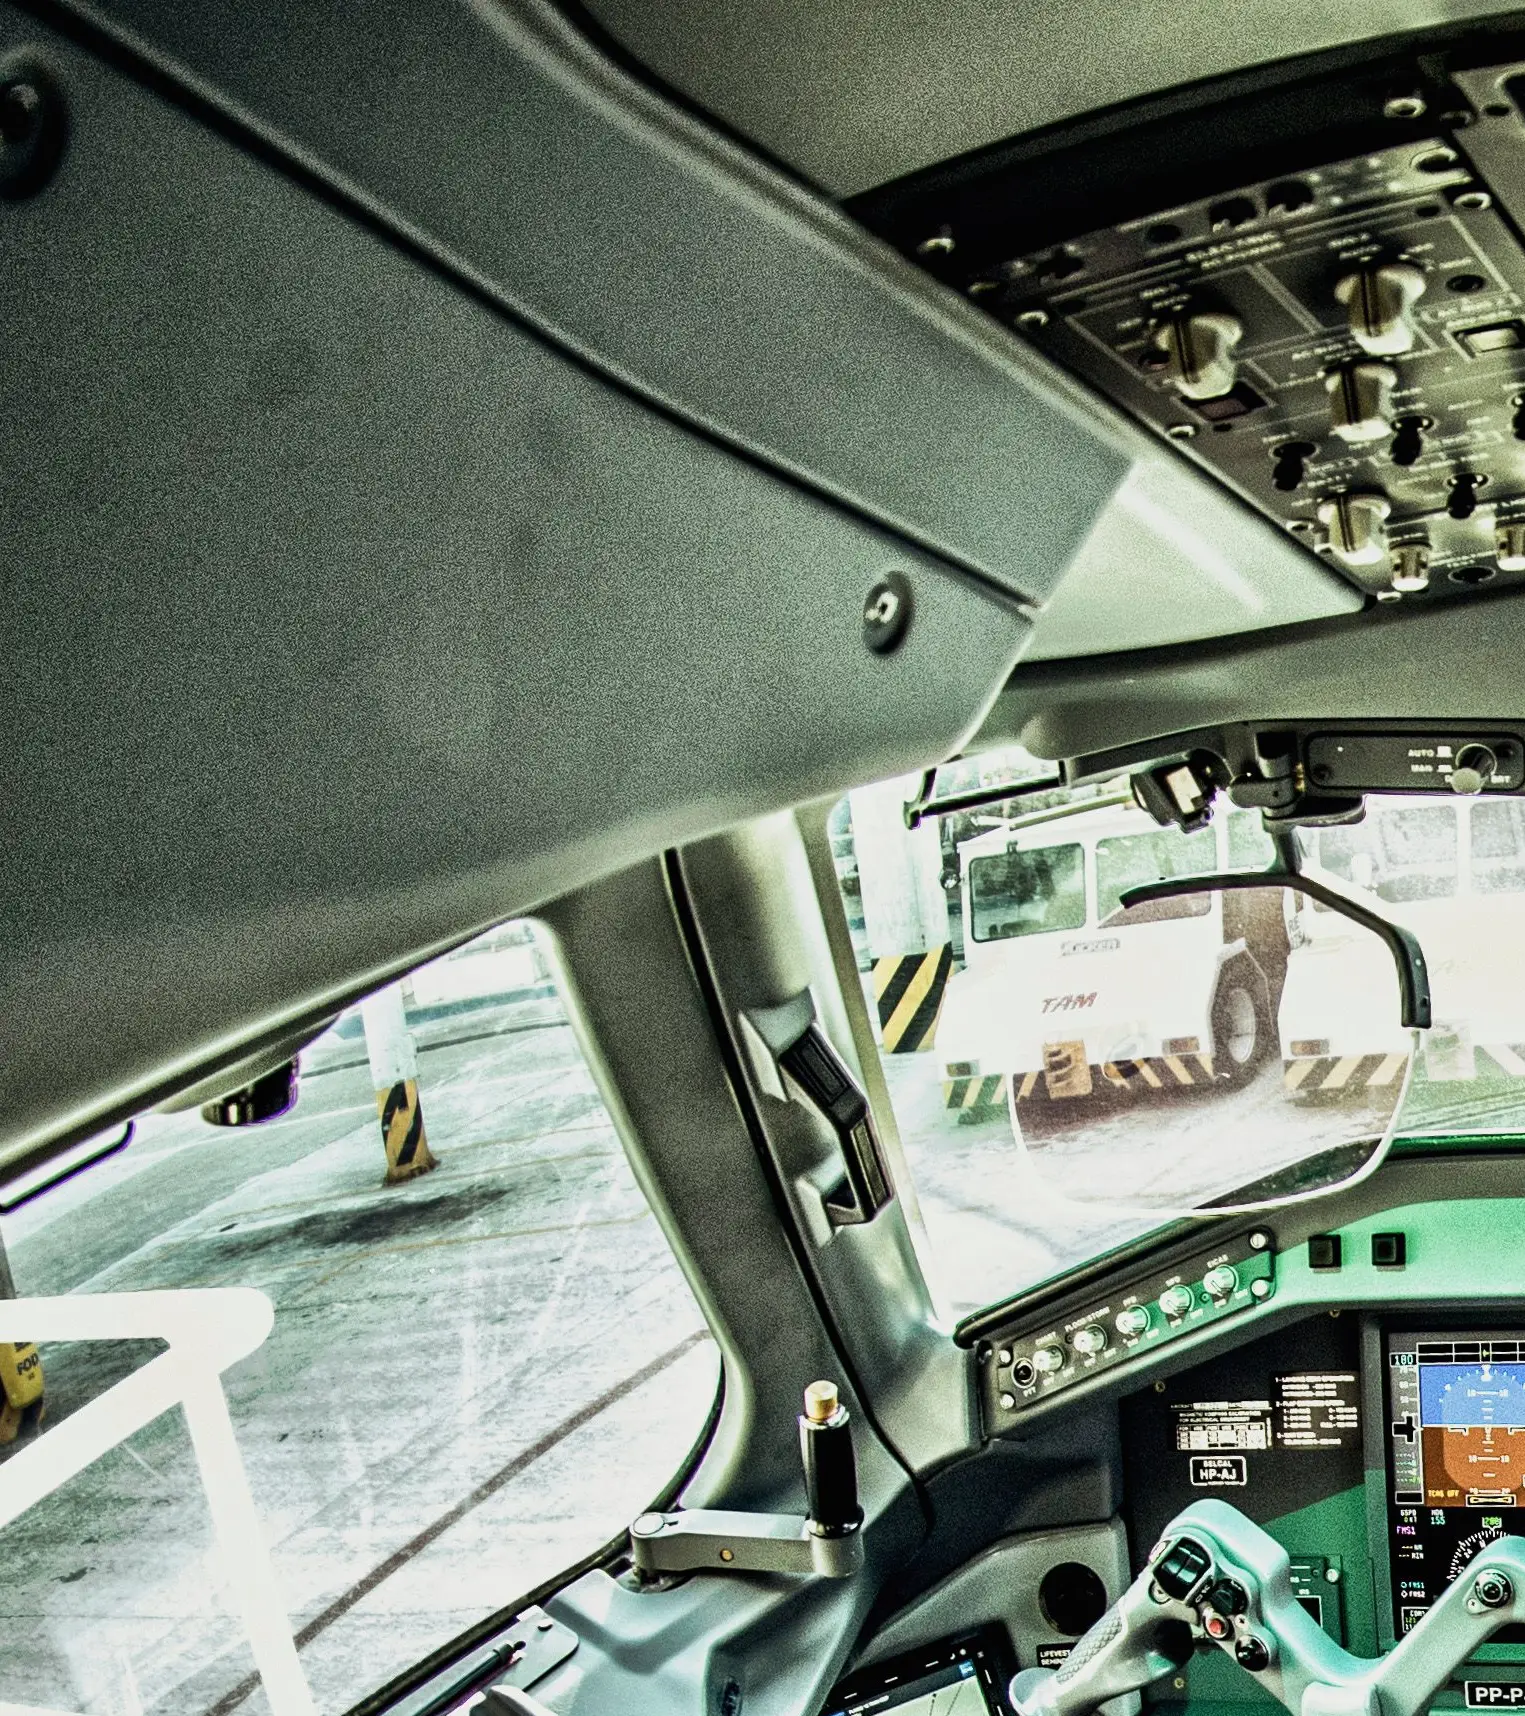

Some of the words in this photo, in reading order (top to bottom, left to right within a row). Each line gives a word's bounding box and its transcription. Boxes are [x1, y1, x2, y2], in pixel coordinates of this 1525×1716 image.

[1041, 992, 1098, 1014] TAM
[1394, 1355, 1414, 1365] 180
[1199, 1469, 1237, 1480] HP-AJ
